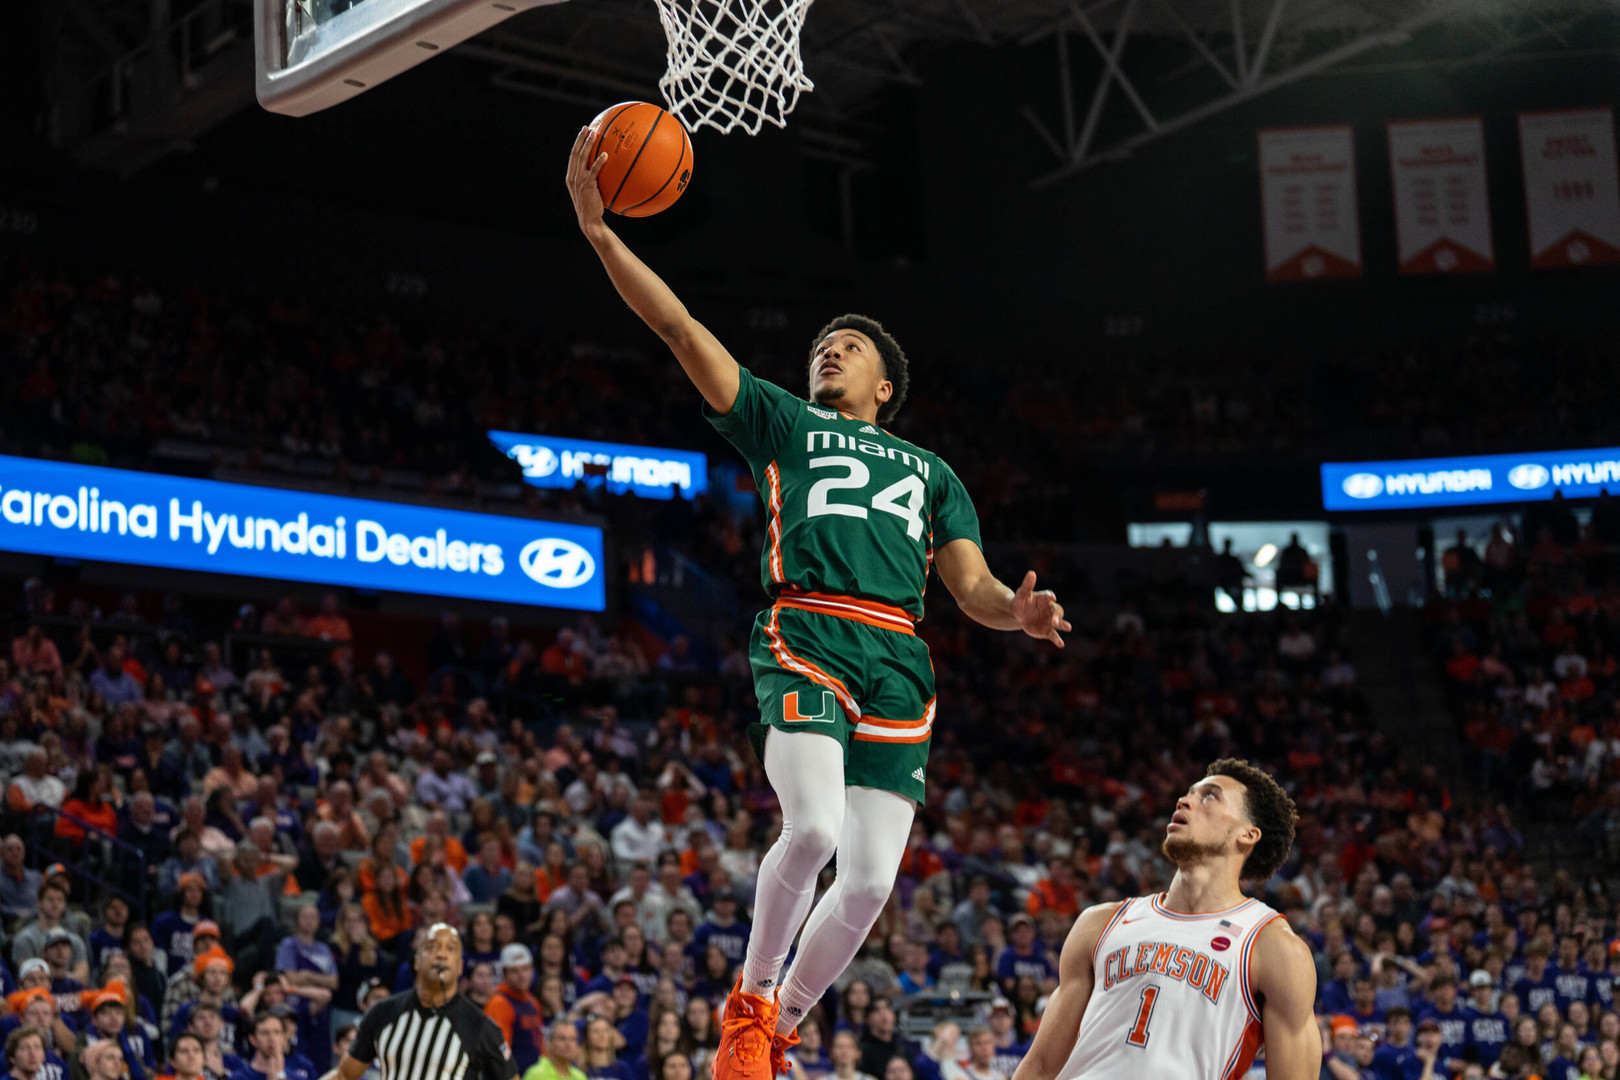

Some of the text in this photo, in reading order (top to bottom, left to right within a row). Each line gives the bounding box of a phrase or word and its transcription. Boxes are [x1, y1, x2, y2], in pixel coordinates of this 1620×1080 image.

[561, 450, 691, 489] HNDAI
[807, 455, 926, 543] 24
[1385, 469, 1492, 495] HYUNDAI
[1552, 460, 1620, 486] HYUN
[0, 485, 505, 576] arolina Hyundai Dealers
[1104, 941, 1230, 1005] CLEMSON
[1126, 984, 1161, 1048] 1
